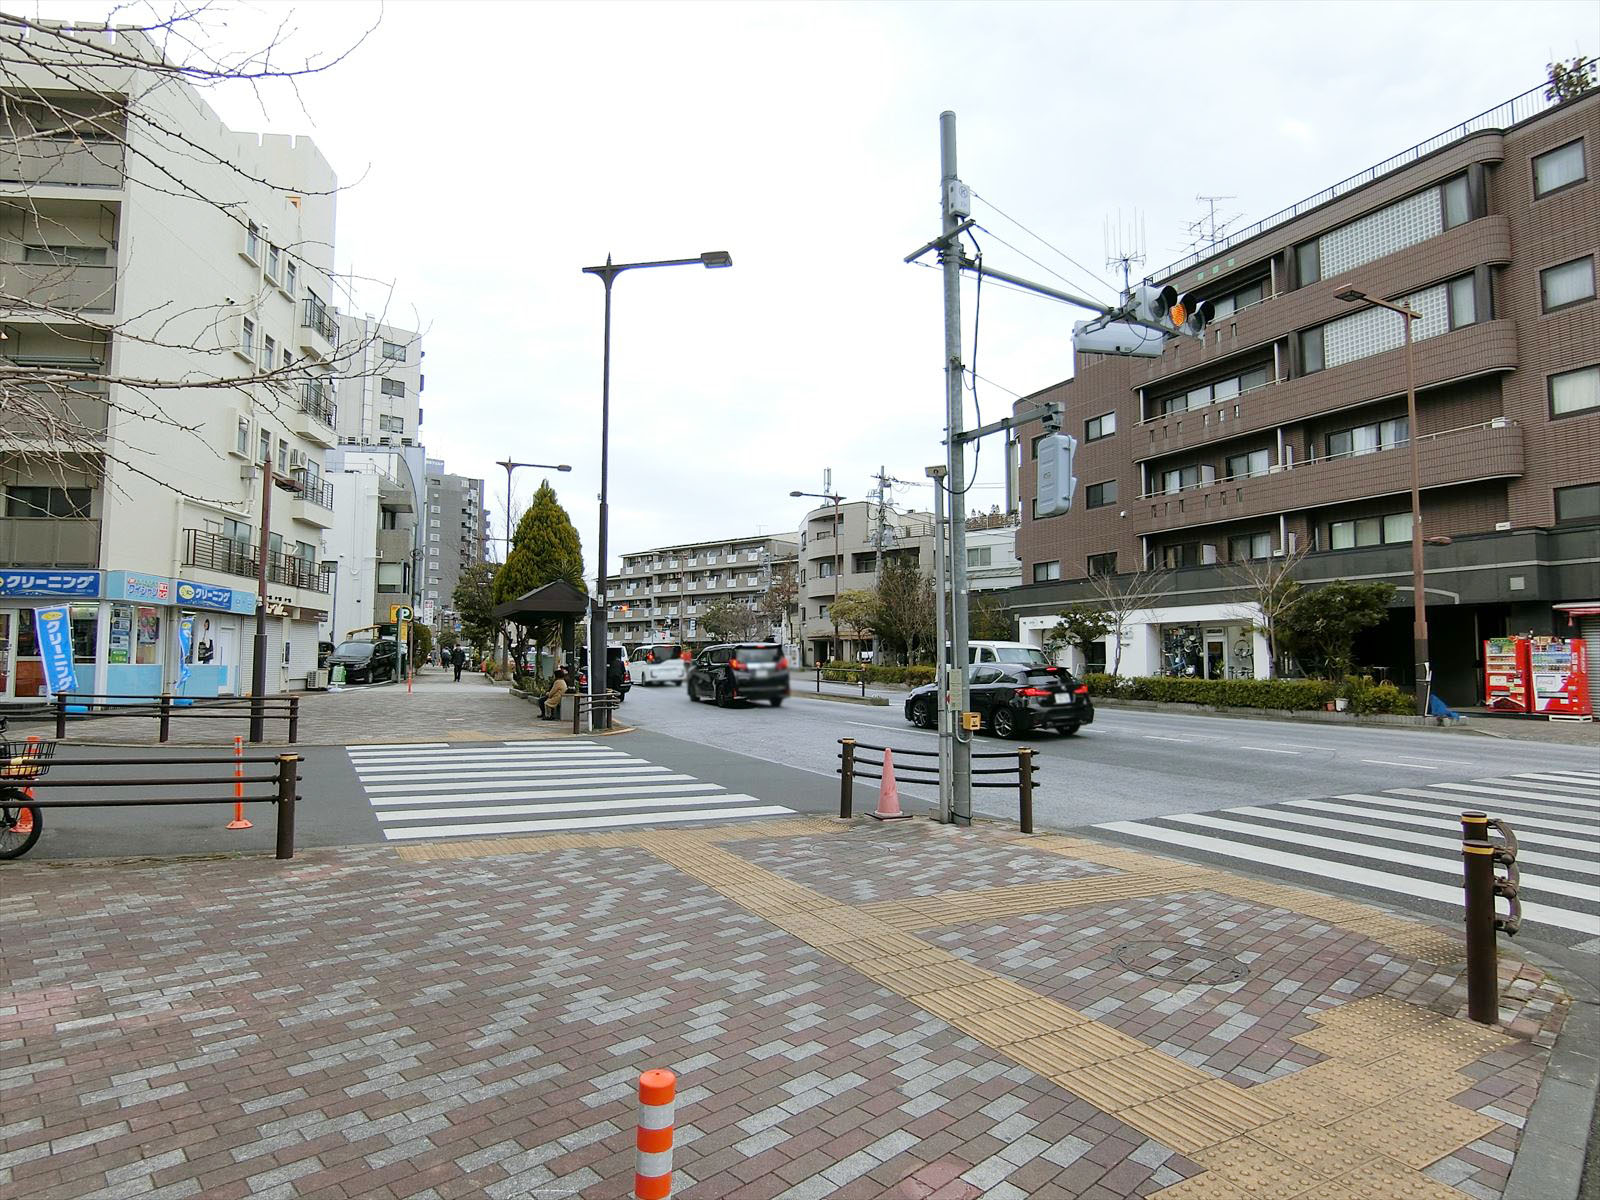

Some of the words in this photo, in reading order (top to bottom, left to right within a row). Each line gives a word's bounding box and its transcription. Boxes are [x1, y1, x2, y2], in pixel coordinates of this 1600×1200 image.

[6, 575, 95, 589] クリーニング
[195, 588, 231, 603] クリーニング
[400, 608, 410, 620] P
[46, 620, 73, 691] クリーニング
